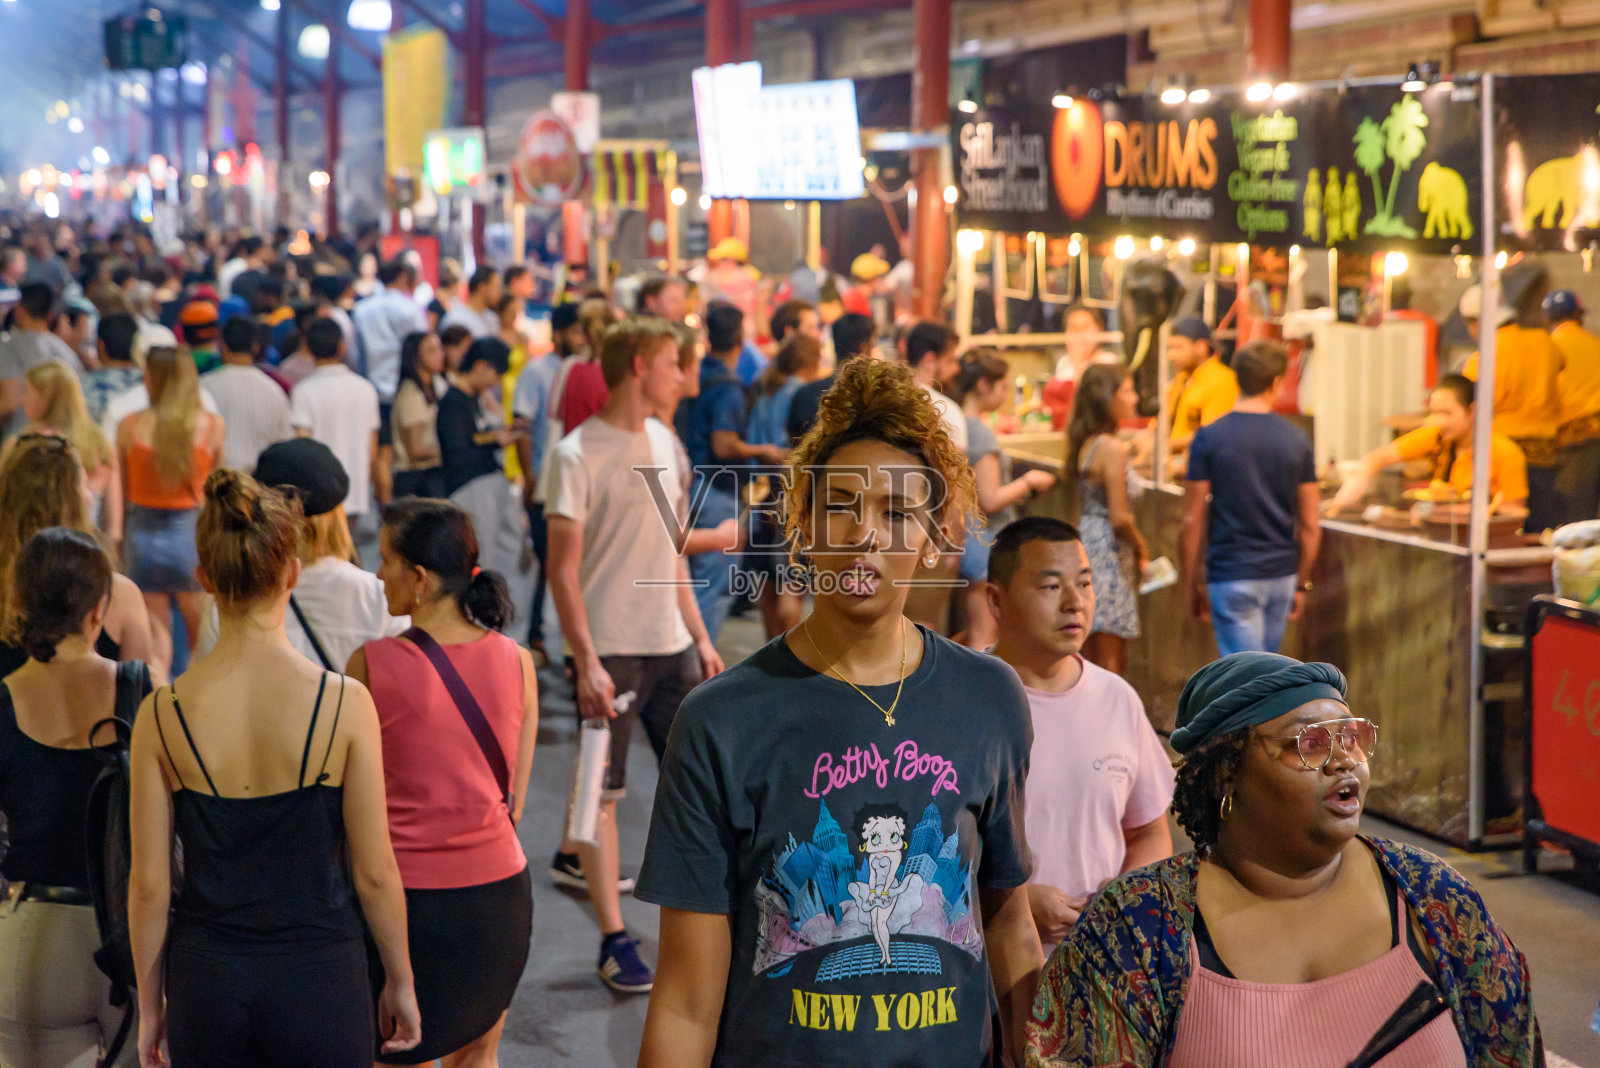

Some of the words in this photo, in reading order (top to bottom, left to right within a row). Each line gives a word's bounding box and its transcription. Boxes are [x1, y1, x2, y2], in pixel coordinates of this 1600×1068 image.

[1104, 117, 1218, 190] DRUMS
[803, 742, 889, 798] Betty
[893, 740, 960, 796] Boop
[788, 988, 861, 1031] NEW
[871, 986, 957, 1031] YORK
